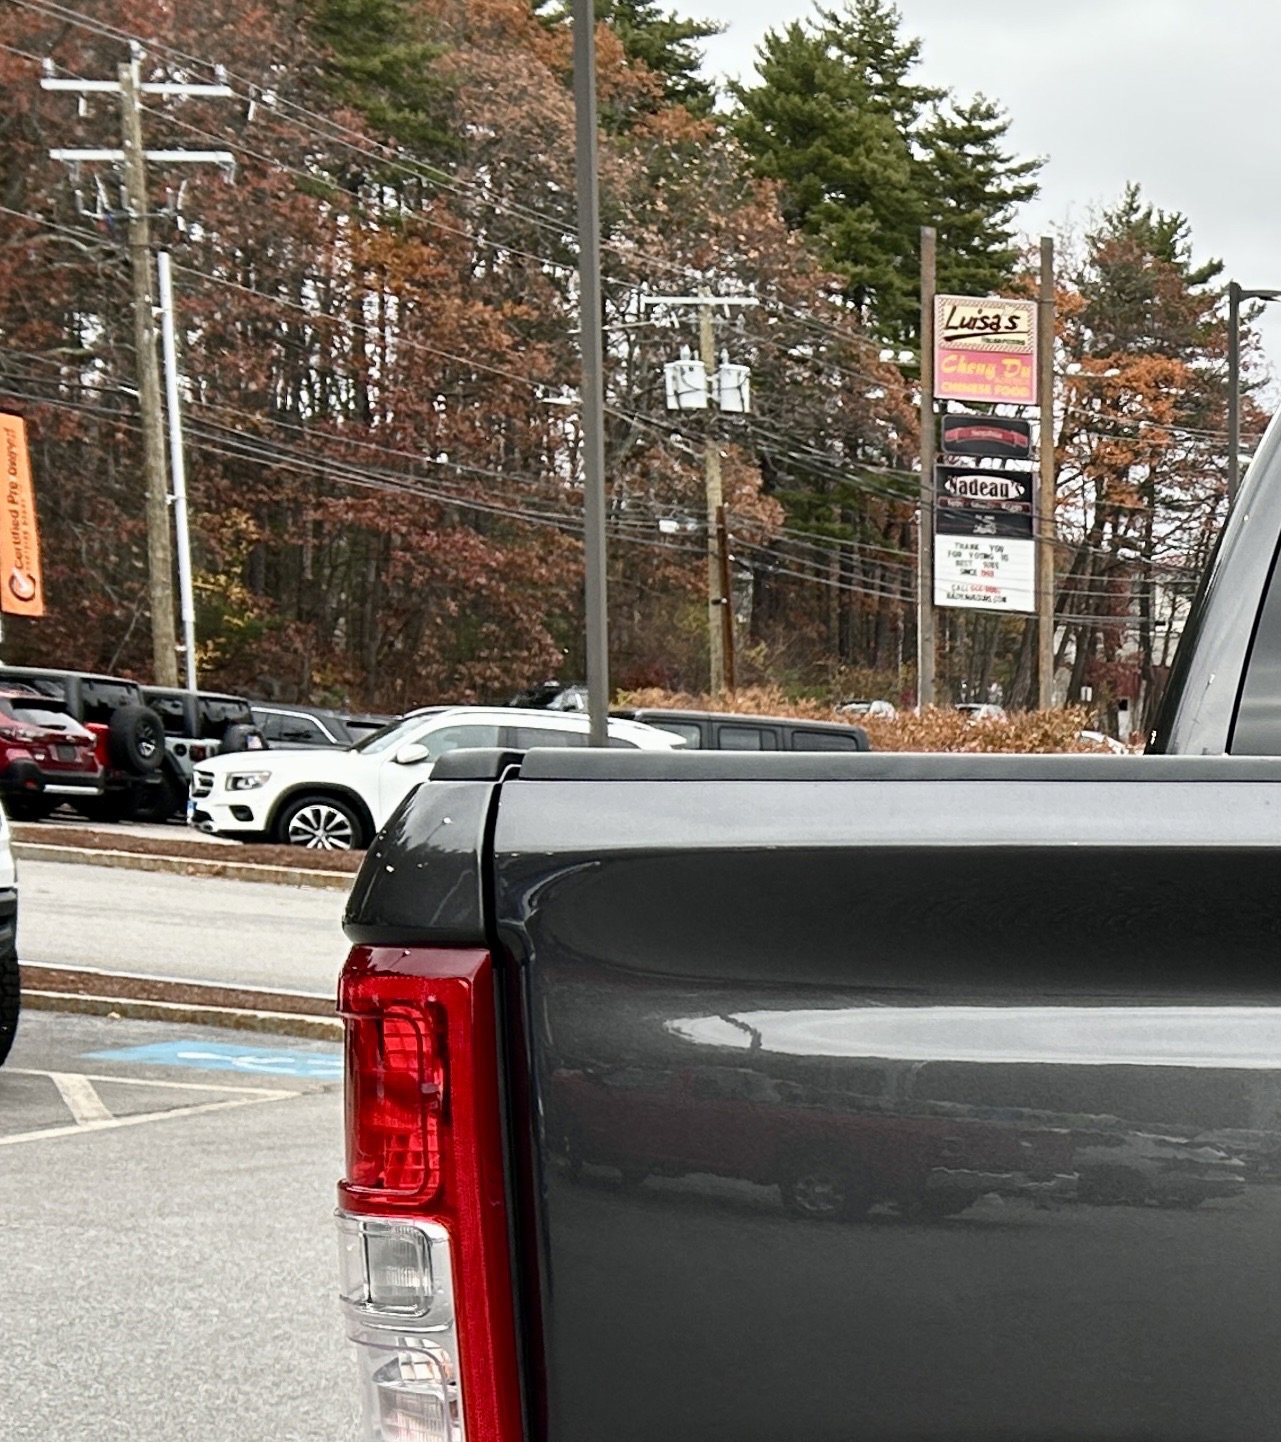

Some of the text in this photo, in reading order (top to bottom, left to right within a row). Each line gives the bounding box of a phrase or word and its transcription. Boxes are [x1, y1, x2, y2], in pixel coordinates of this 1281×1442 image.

[994, 385, 1030, 396] FOOD
[6, 480, 19, 504] Pre
[947, 475, 1022, 498] Nadeau's
[7, 508, 24, 569] Certified
[947, 550, 962, 558] FOR
[989, 544, 1004, 553] YOU
